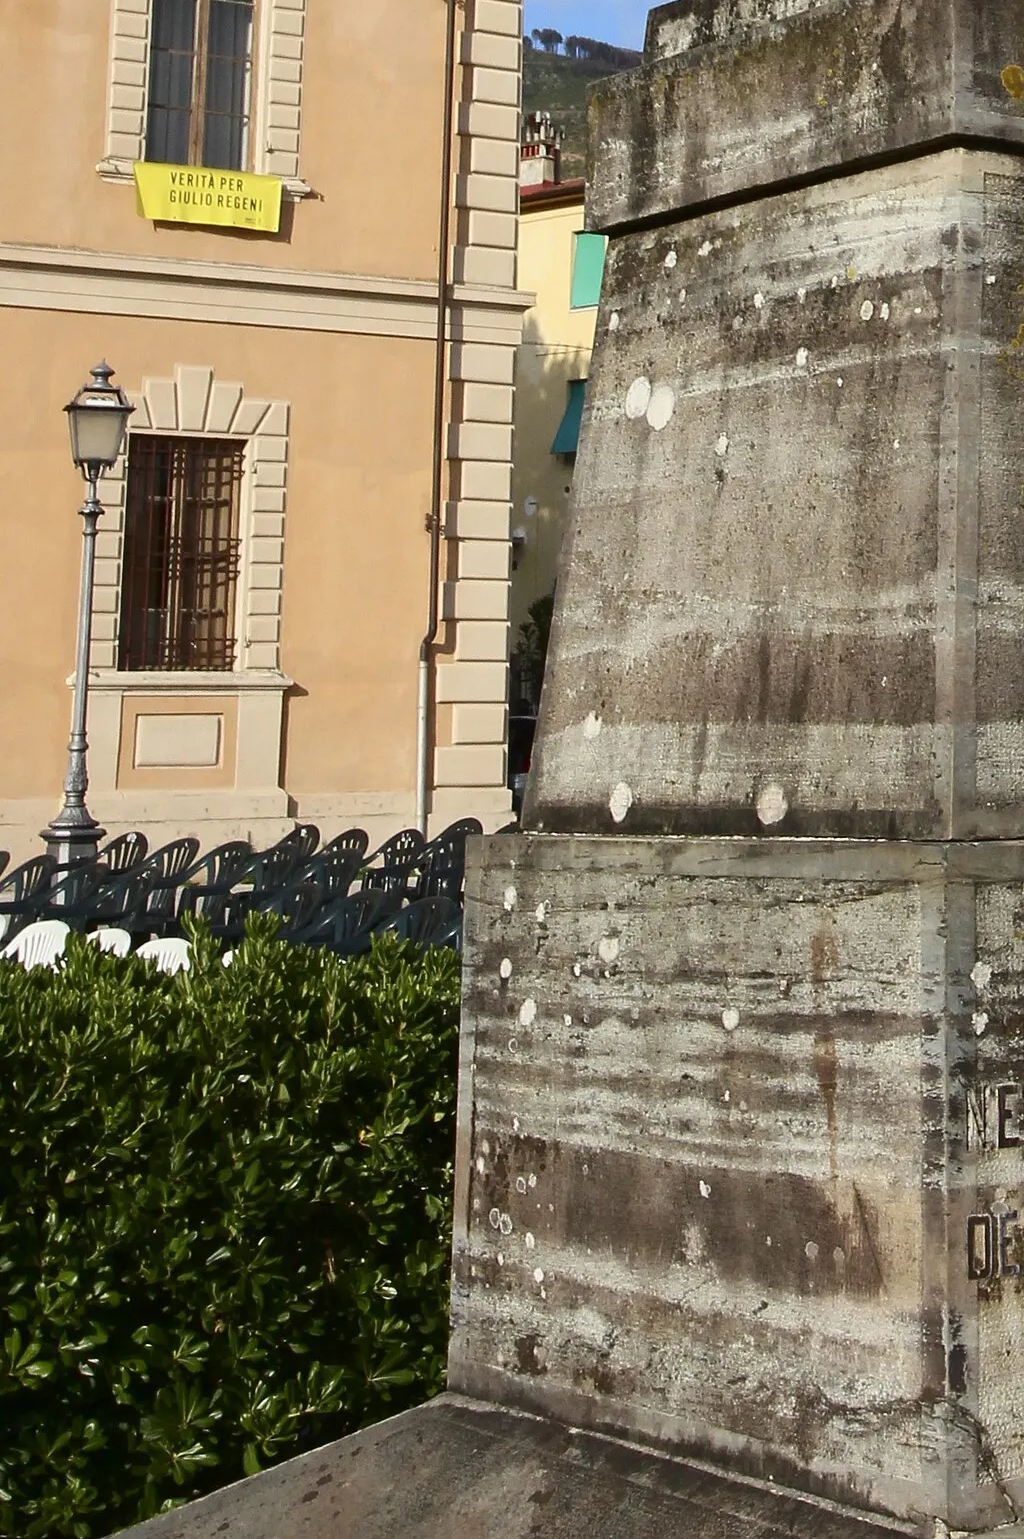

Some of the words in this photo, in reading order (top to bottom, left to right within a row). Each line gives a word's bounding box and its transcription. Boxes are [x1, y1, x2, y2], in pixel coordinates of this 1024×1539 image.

[170, 171, 215, 189] VERITÀ
[220, 177, 244, 192] PER
[169, 190, 213, 206] GIULIO
[217, 194, 263, 212] REGENI
